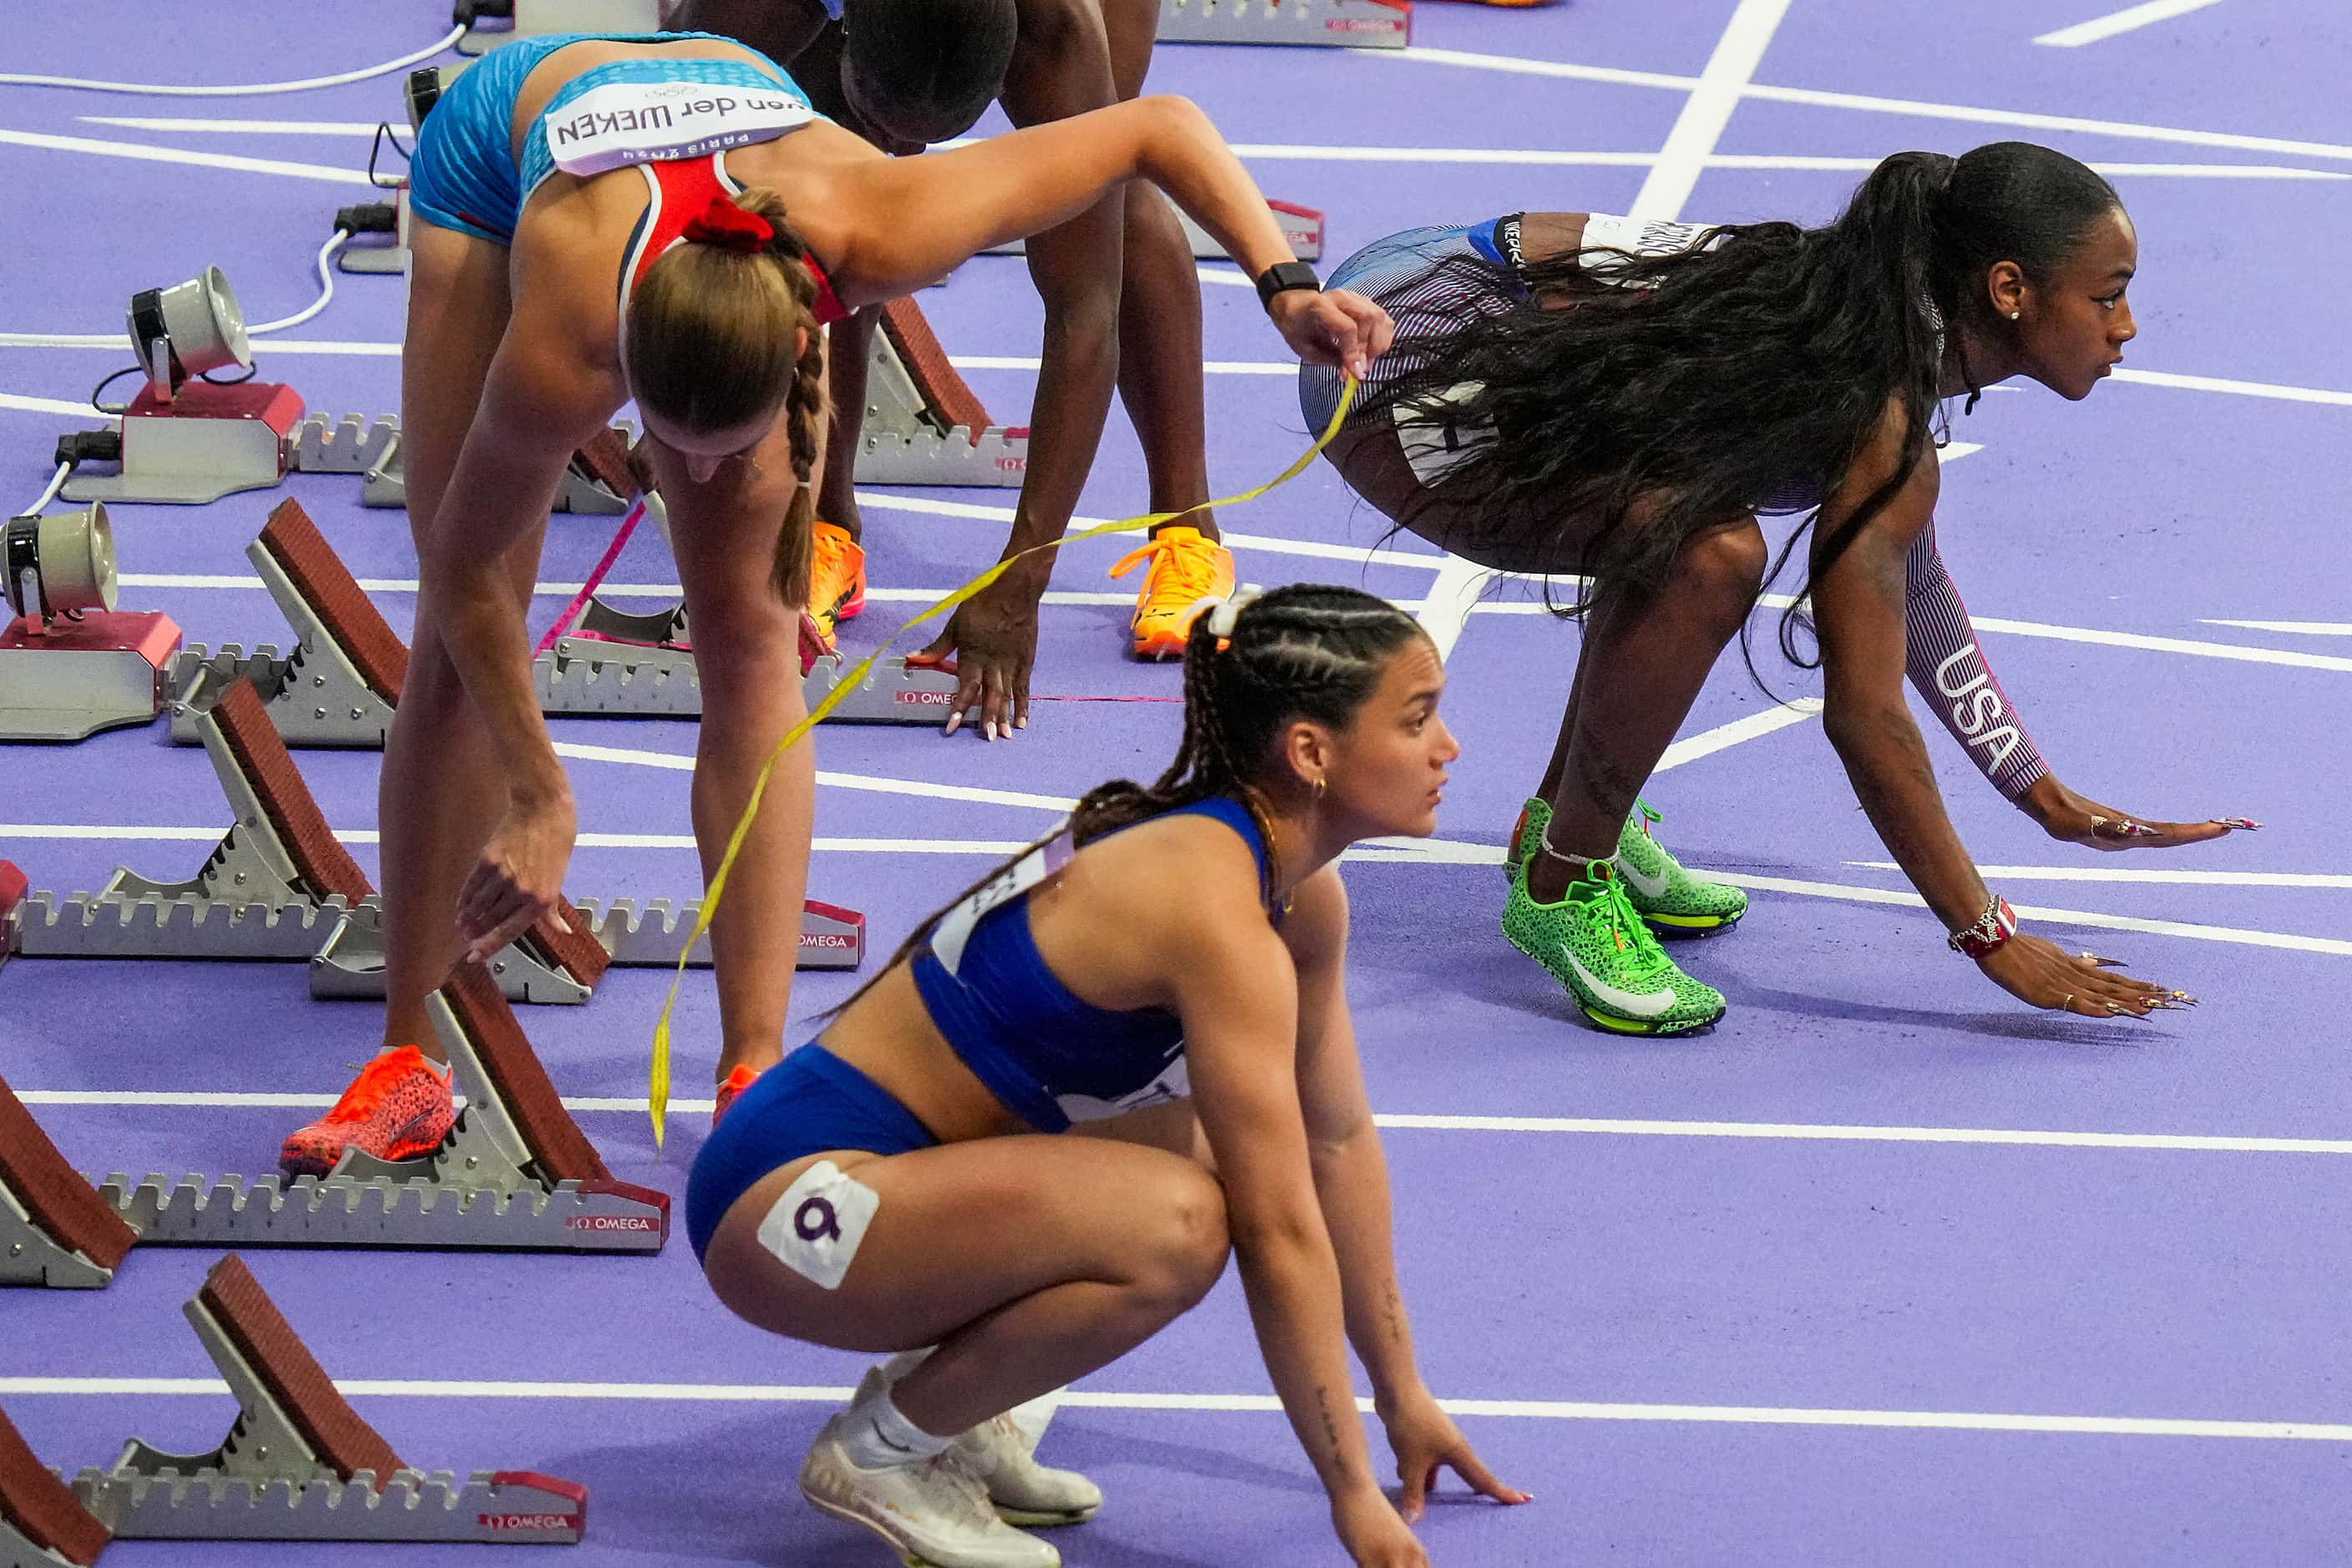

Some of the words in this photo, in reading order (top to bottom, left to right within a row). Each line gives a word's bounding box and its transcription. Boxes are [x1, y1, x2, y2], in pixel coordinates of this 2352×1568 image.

[681, 97, 736, 117] der
[557, 105, 673, 145] WEKEN
[687, 133, 750, 155] PARIS
[921, 692, 958, 705] OME
[1935, 642, 2020, 776] USA
[798, 934, 847, 948] OMEGA
[594, 1217, 650, 1230] OMEGA
[508, 1515, 569, 1530] OMEGA
